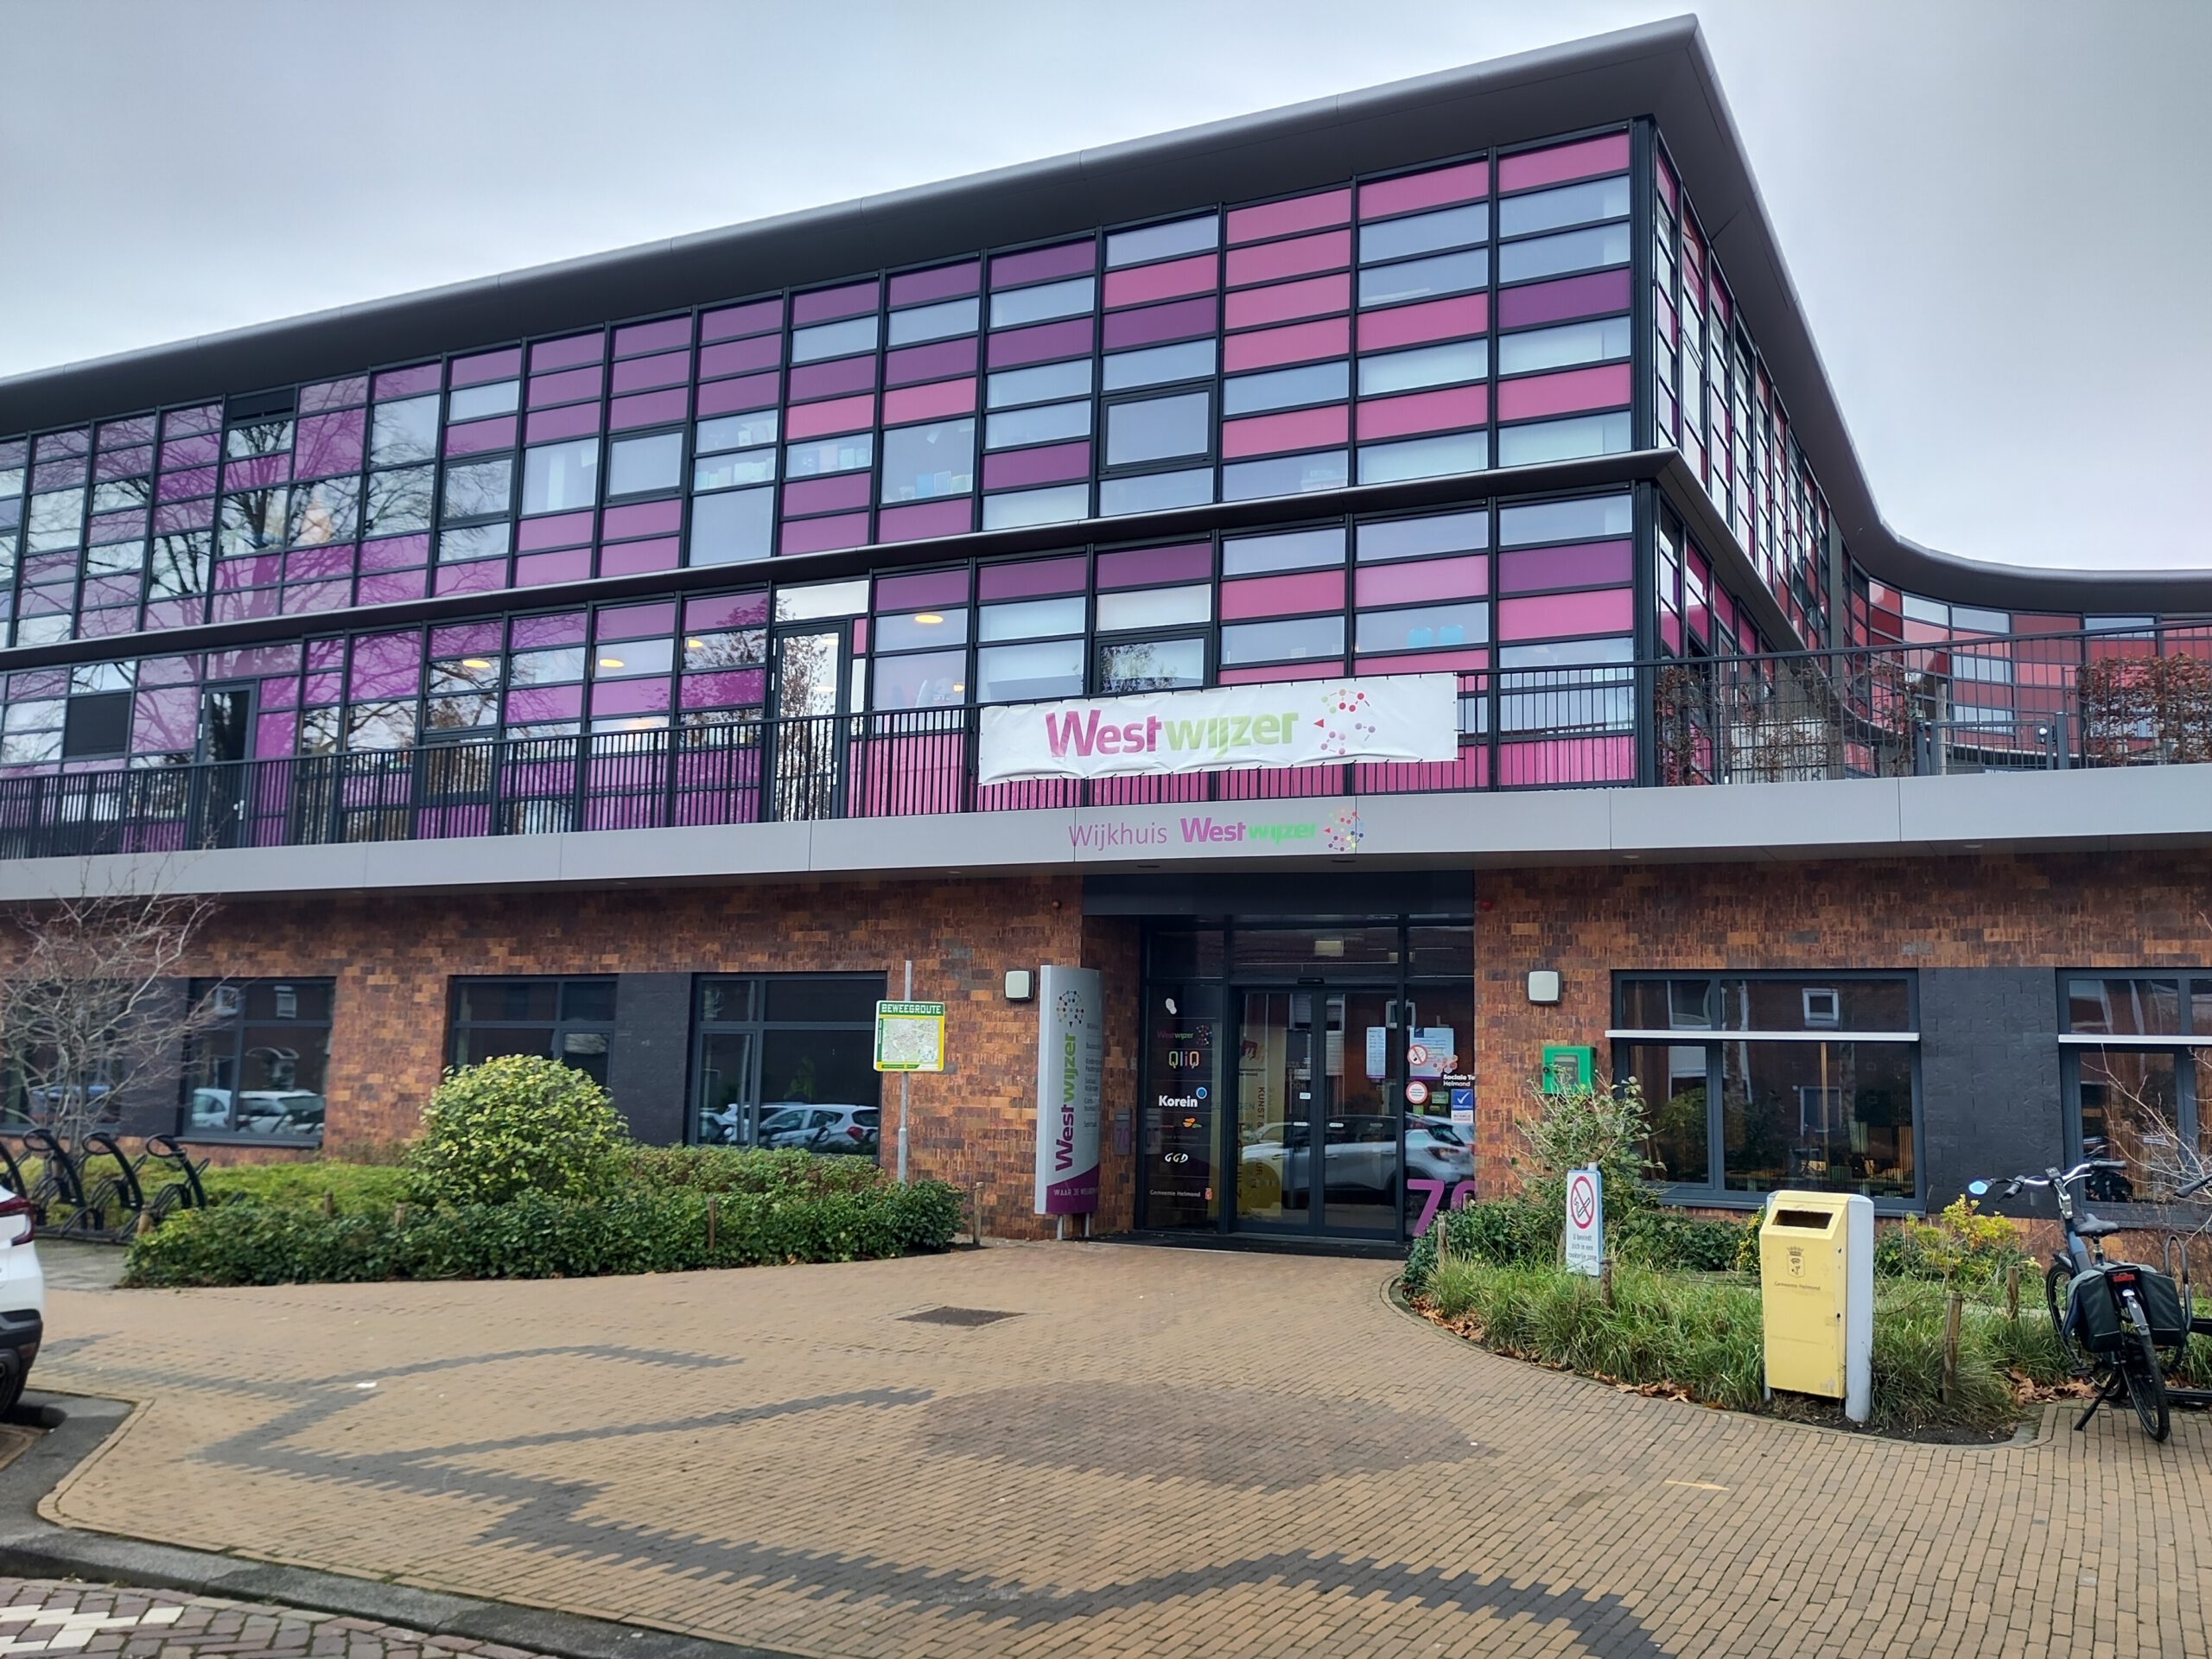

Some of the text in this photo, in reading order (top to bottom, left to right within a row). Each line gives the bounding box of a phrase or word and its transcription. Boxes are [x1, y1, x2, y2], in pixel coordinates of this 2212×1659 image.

[1045, 709, 1299, 760] Westwijzer
[1068, 817, 1317, 851] Wijkhuis Westwijzer
[881, 1003, 942, 1014] BEWEEGROUTE
[1055, 1032, 1078, 1172] Westwijzer
[1158, 1095, 1198, 1108] Korein
[1164, 1152, 1189, 1164] GGD
